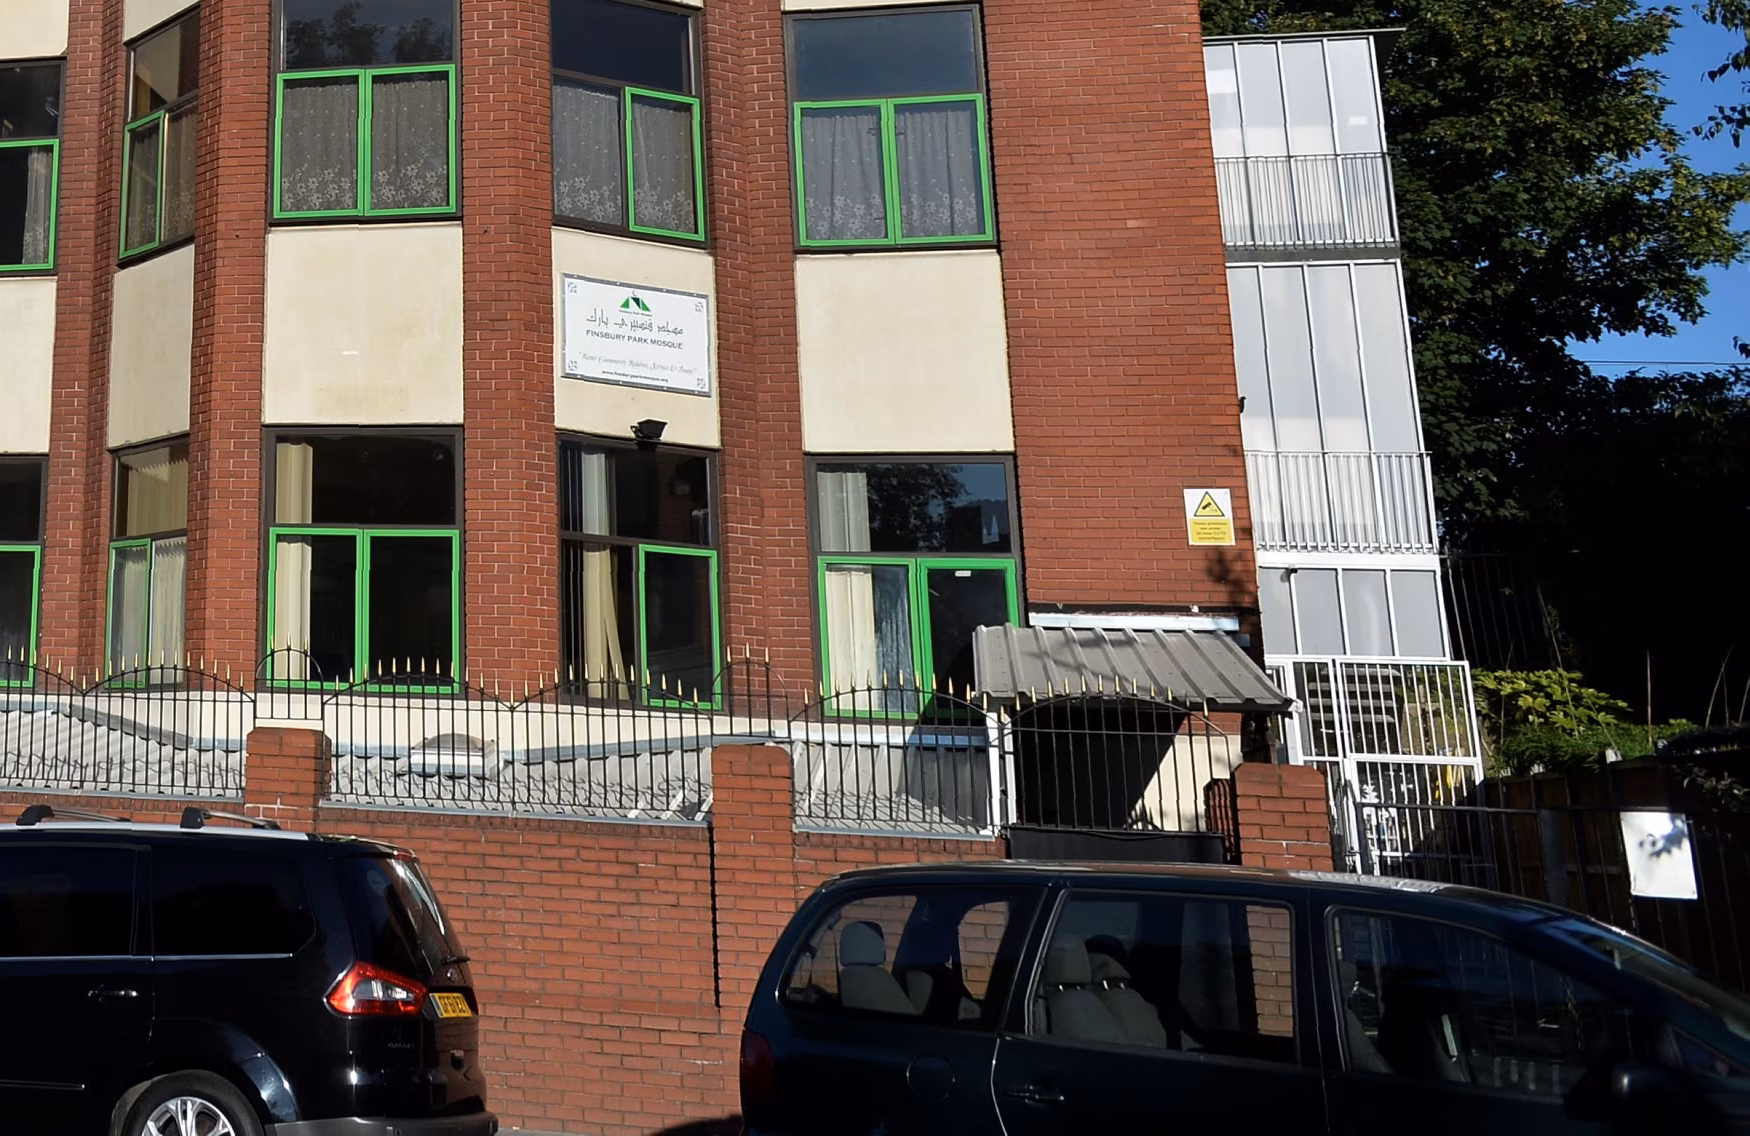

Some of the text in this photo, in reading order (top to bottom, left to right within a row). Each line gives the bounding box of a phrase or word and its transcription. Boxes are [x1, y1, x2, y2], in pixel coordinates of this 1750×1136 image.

[586, 329, 683, 350] FINSBURY PARK MOSQUE
